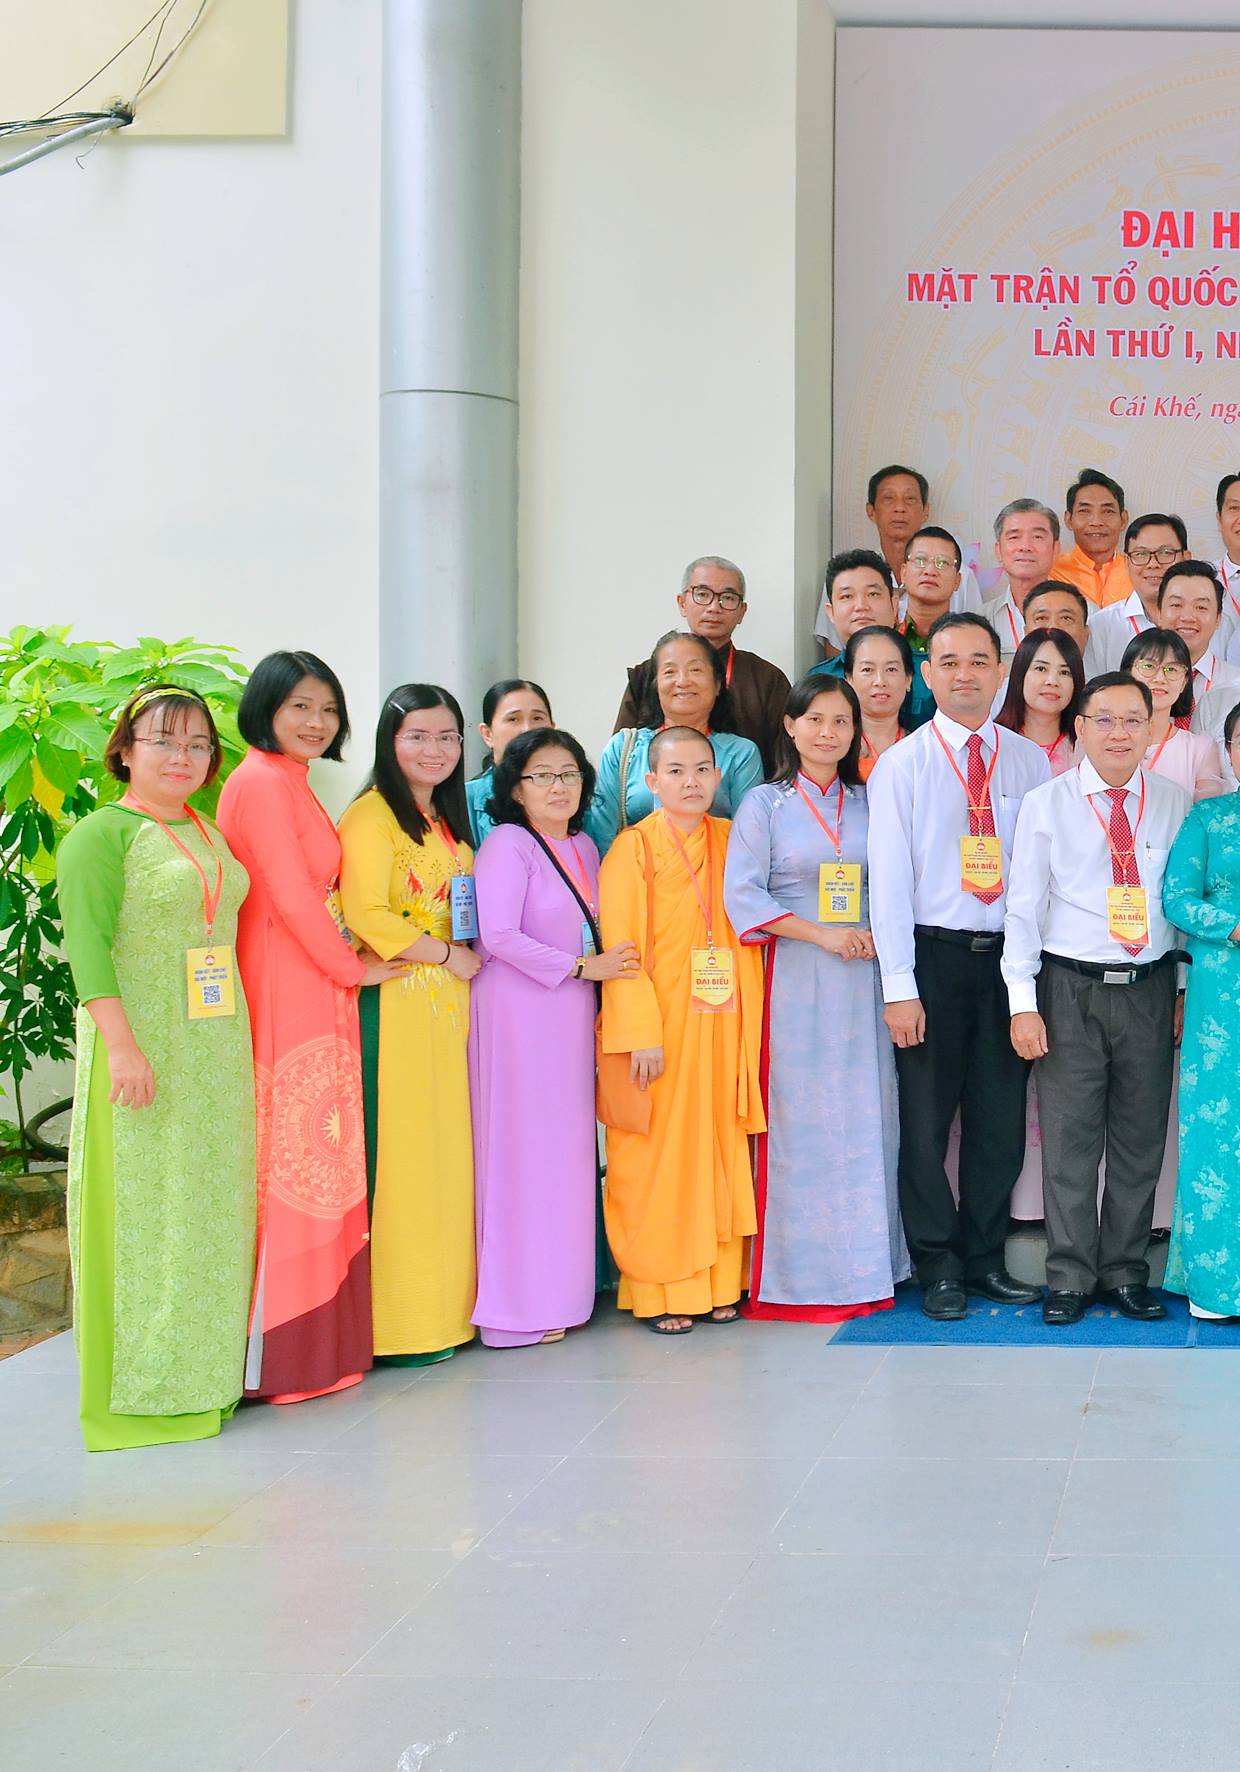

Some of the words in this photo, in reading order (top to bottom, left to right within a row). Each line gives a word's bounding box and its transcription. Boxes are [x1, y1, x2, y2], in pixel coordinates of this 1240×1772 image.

[1121, 210, 1195, 257] ĐẠI
[907, 267, 979, 309] MẶT
[990, 266, 1081, 311] TRẬN
[1091, 260, 1139, 305] TỔ
[1147, 265, 1239, 311] QUỐC
[1034, 317, 1096, 357] LẦN
[1106, 323, 1175, 358] THỨ
[1185, 331, 1205, 364] I,
[1109, 395, 1149, 419] Cái
[1154, 392, 1203, 421] Khế,
